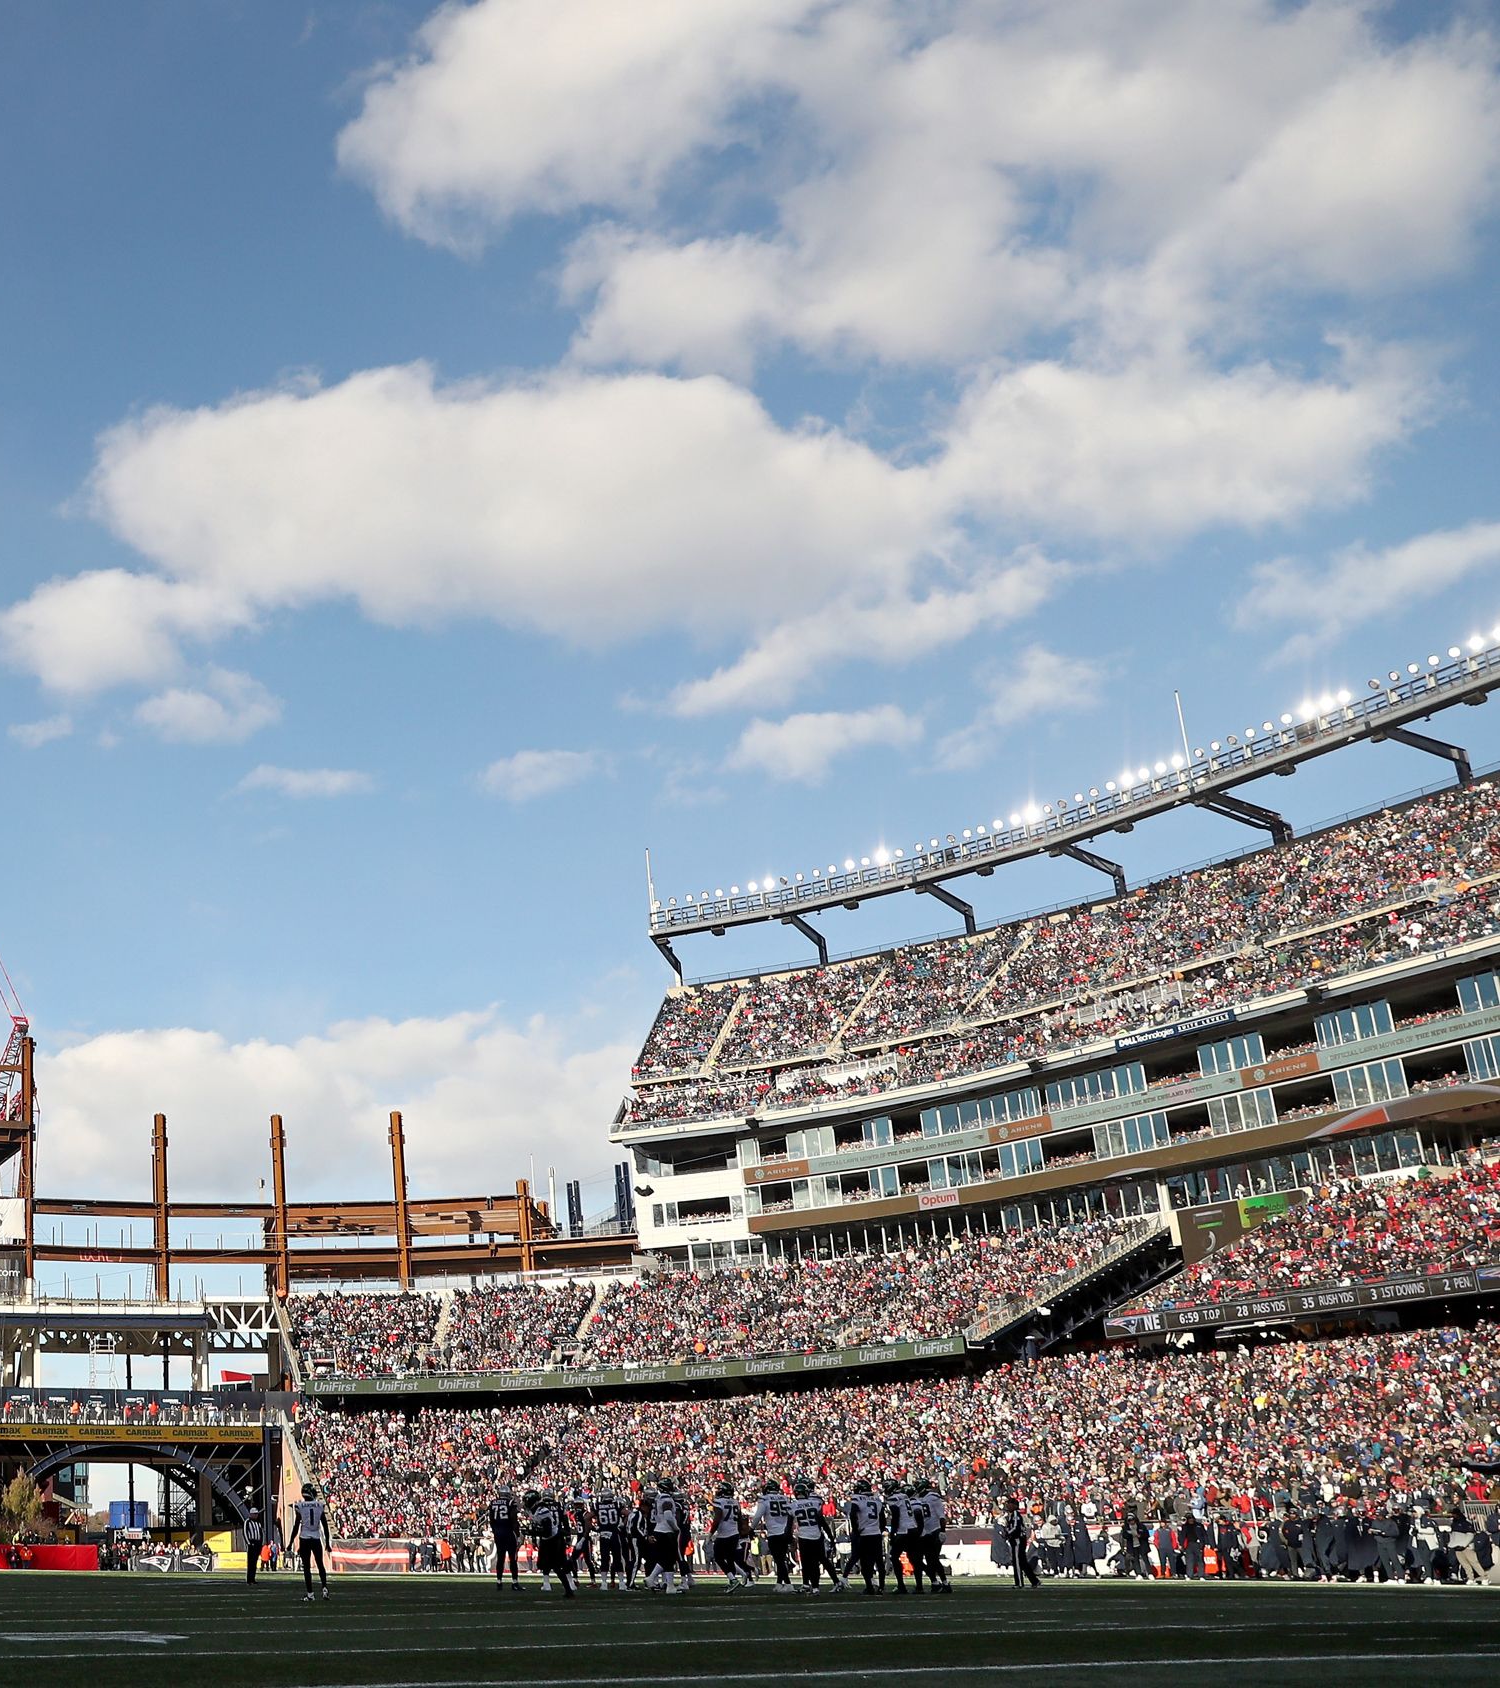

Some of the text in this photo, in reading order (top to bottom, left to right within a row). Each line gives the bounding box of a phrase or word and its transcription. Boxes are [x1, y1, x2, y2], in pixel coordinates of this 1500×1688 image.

[1118, 1037, 1137, 1048] DELL
[1136, 1028, 1175, 1042] Technologies
[1328, 1050, 1358, 1061] OFFICIAL
[1378, 1038, 1405, 1051] MOWER
[1414, 1032, 1429, 1042] THE
[1430, 1028, 1448, 1038] NEW
[1448, 1020, 1484, 1033] ENGLAND
[1267, 1063, 1307, 1076] ARIENS
[1184, 1083, 1213, 1096] PATRIOTS
[1010, 1122, 1043, 1133] ARIENS
[766, 1166, 800, 1176] ARIENS
[921, 1193, 956, 1206] Optum
[1442, 1275, 1473, 1291] 2 PEN.
[1371, 1282, 1426, 1300] 3 1ST DOWNS
[1302, 1291, 1354, 1309] 35 RUSH YDS
[1236, 1300, 1286, 1317] 28 PASS YDS
[1144, 1316, 1161, 1331] NE
[1179, 1312, 1200, 1324] 6:59
[859, 1348, 897, 1362] UniFirst
[914, 1342, 954, 1355] UniFirst
[746, 1360, 786, 1372] UniFirst
[802, 1354, 843, 1368] UniFirst
[624, 1369, 666, 1381] UniFirst
[685, 1365, 727, 1377] UniFirst
[438, 1378, 481, 1390] UniFirst
[500, 1376, 544, 1388] UniFirst
[563, 1373, 605, 1385] UniFirst
[314, 1382, 357, 1392] UniFirst
[375, 1380, 419, 1392] UniFirst
[492, 1505, 508, 1520] 72
[770, 1500, 788, 1516] 95
[866, 1502, 878, 1520] 3
[310, 1508, 315, 1526] 1
[598, 1508, 618, 1525] 60
[794, 1508, 818, 1526] 29
